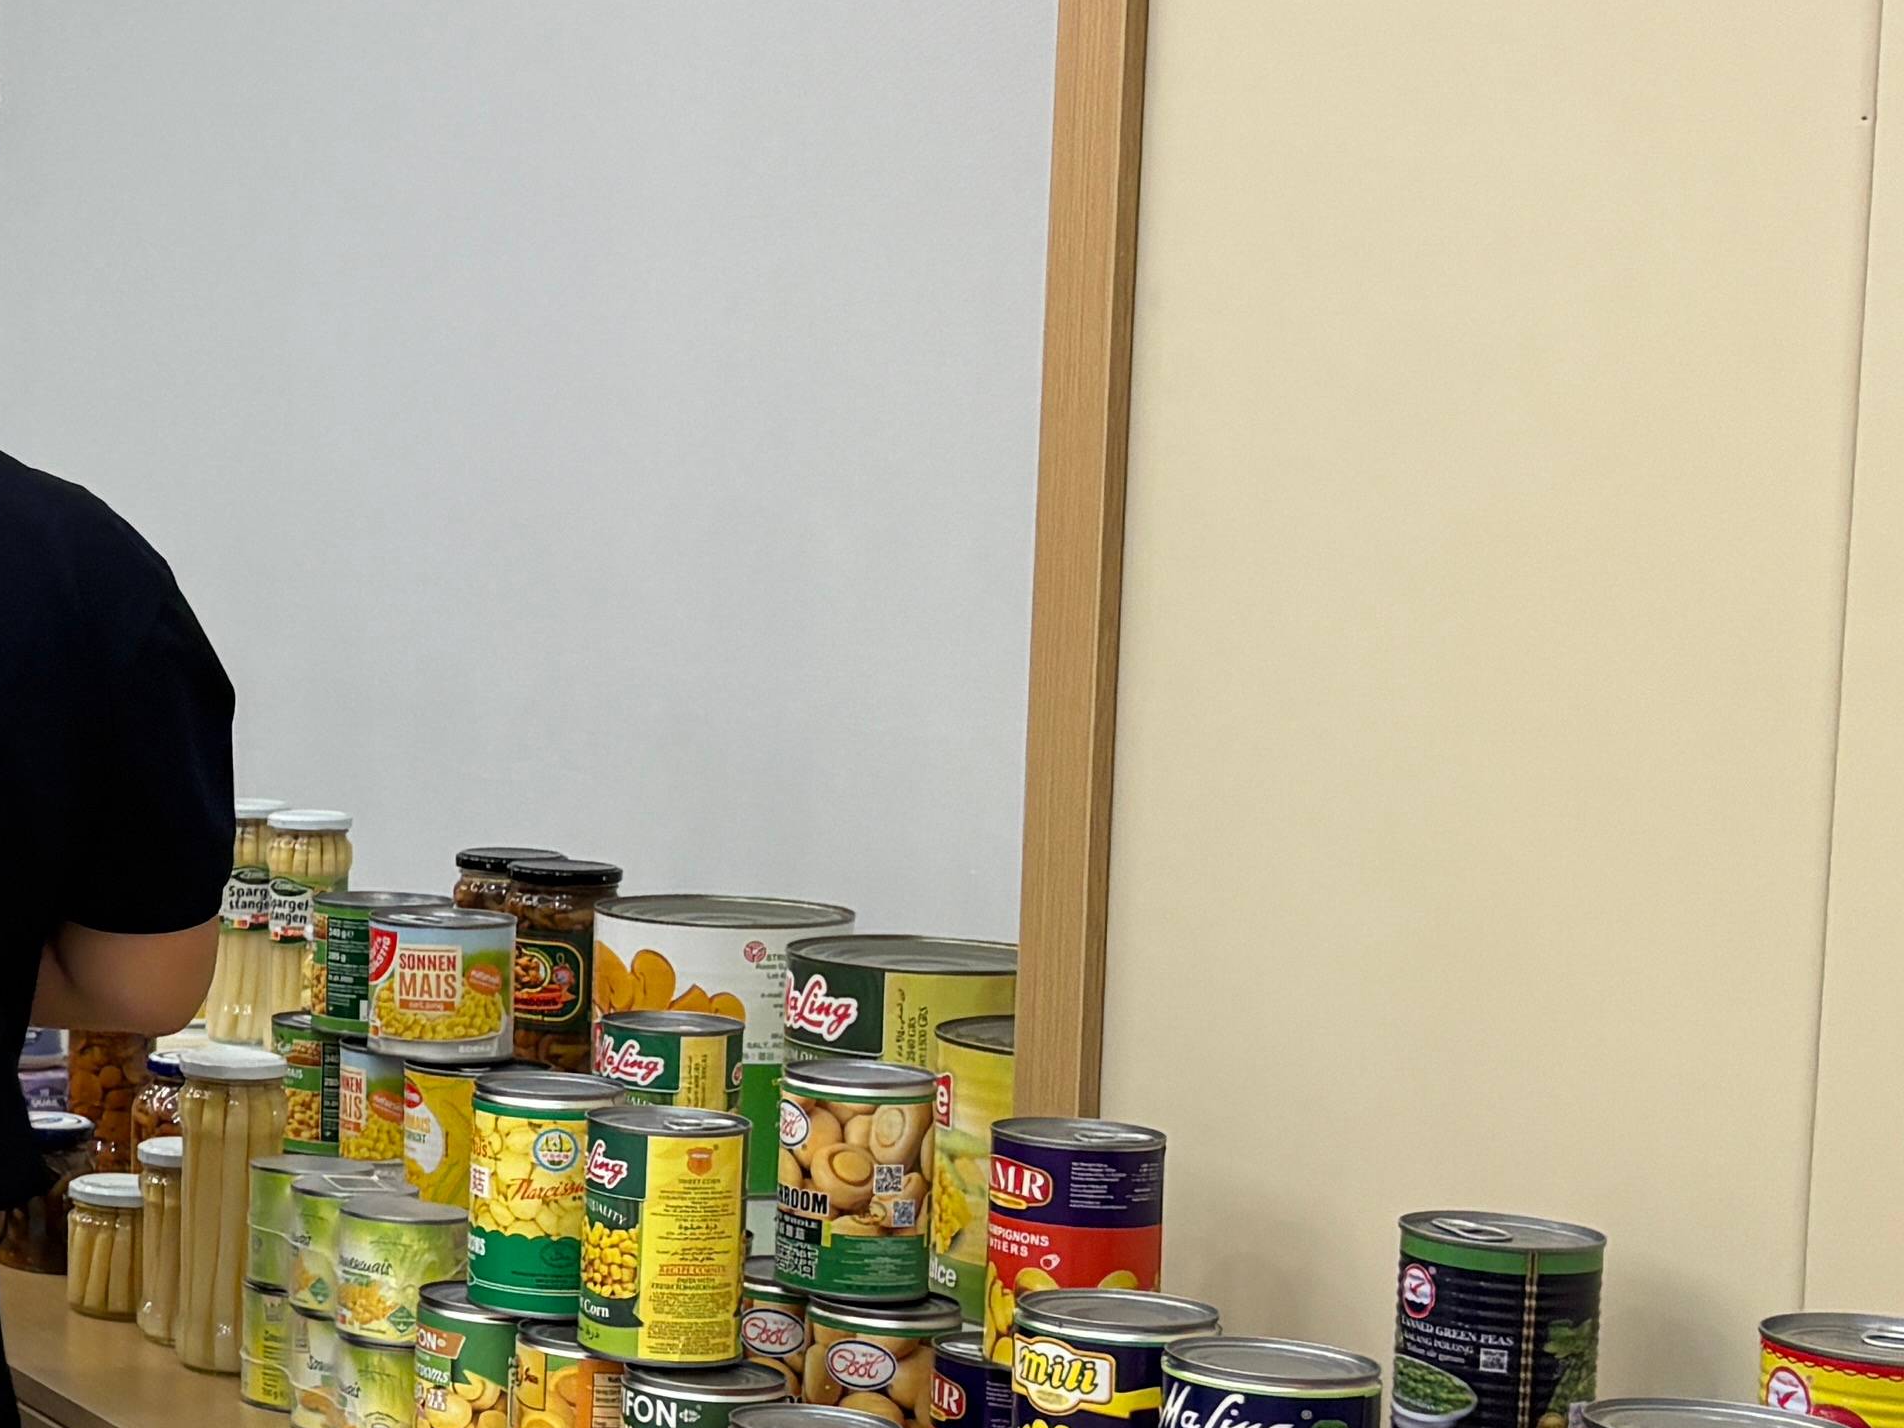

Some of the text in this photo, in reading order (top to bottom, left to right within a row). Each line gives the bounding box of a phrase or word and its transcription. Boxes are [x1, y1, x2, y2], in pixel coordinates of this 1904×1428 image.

[228, 885, 269, 900] Sparg
[399, 953, 457, 972] SONNEN
[399, 972, 457, 999] MAIS
[342, 1094, 363, 1120] AIS
[585, 1139, 627, 1188] Ling
[509, 1177, 585, 1201] Narcissu
[992, 1160, 1045, 1200] M.R
[590, 1199, 628, 1226] UALITY
[779, 1185, 829, 1215] HROOM
[990, 1225, 1050, 1247] MPIGNONS
[585, 1297, 611, 1319] Corn
[418, 1328, 437, 1350] ON
[1435, 1326, 1477, 1342] GREEN
[1479, 1333, 1515, 1347] PEAS
[1021, 1346, 1099, 1395] mili
[622, 1388, 677, 1428] FON
